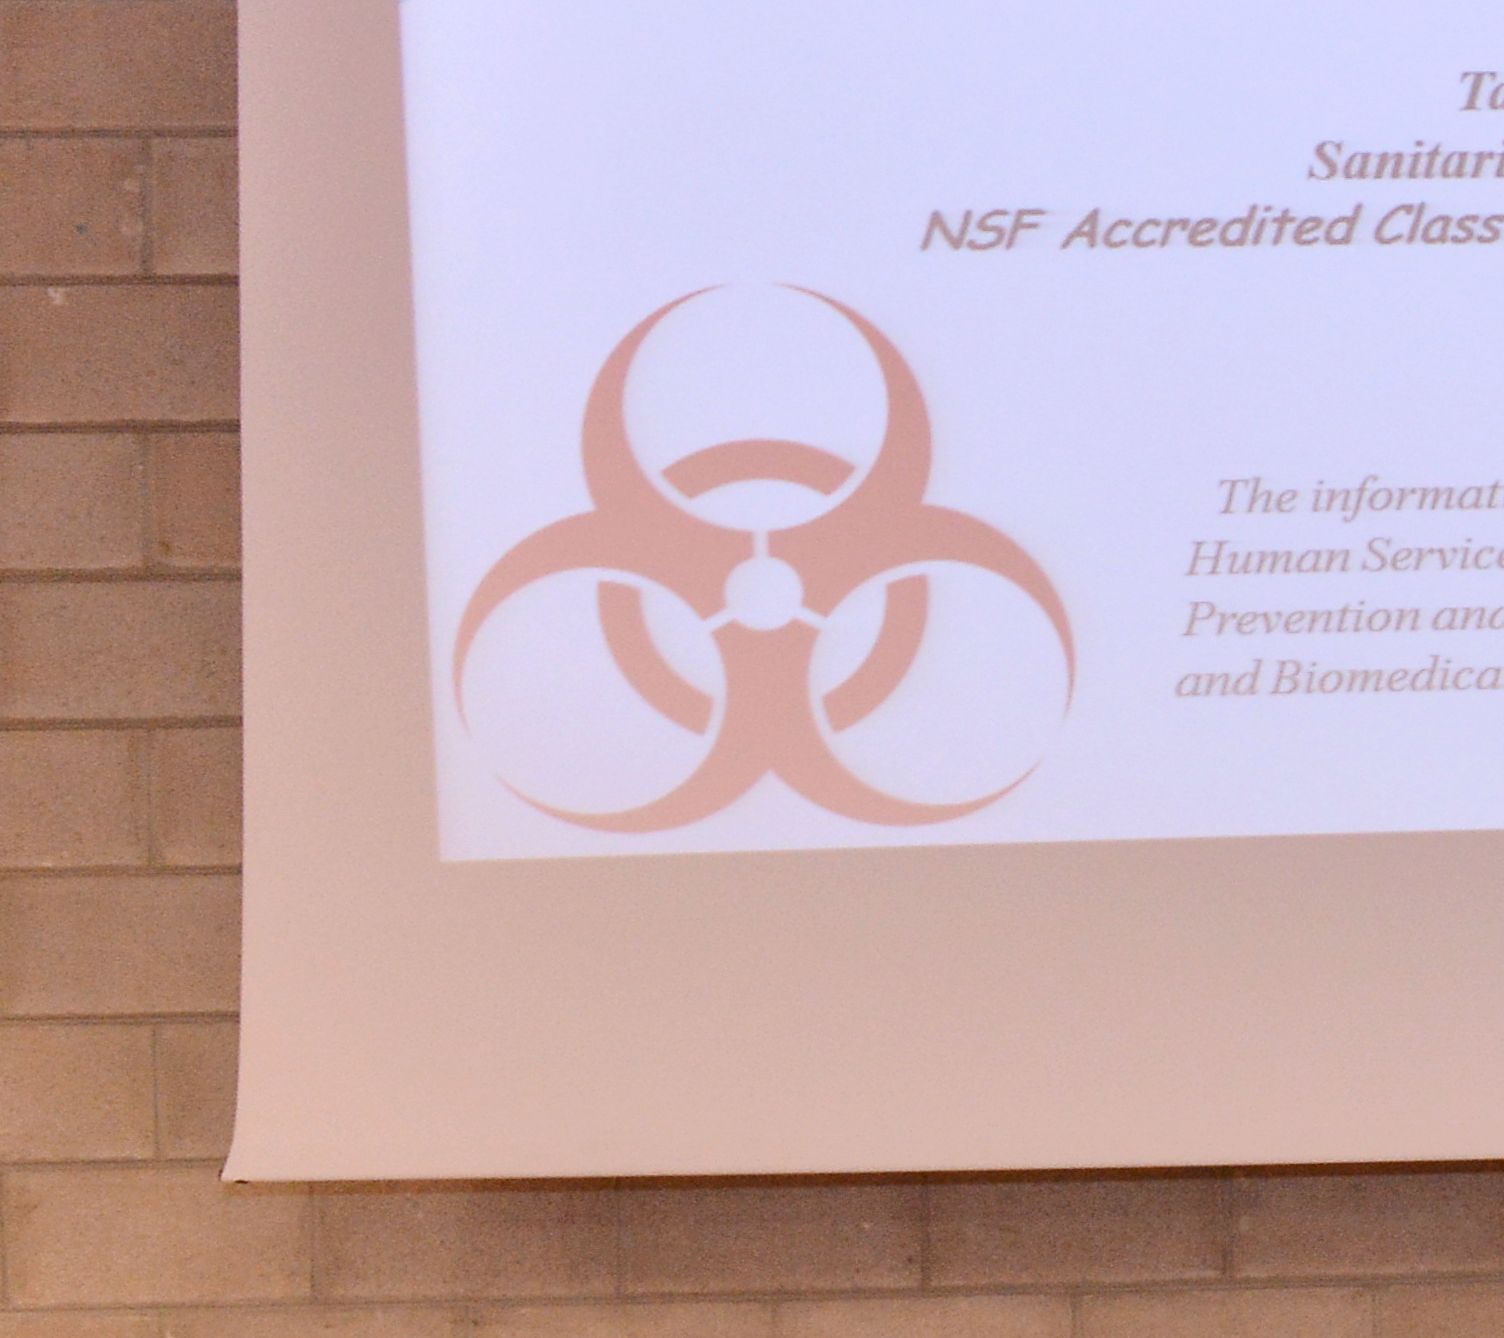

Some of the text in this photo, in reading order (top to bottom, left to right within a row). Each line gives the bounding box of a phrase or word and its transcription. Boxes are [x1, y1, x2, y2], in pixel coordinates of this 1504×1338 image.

[920, 207, 1048, 252] NSF
[1060, 202, 1361, 250] Accredited
[1218, 475, 1299, 516] The
[1185, 539, 1352, 577] Human
[1181, 599, 1421, 638] Prevention
[1174, 657, 1264, 698] and
